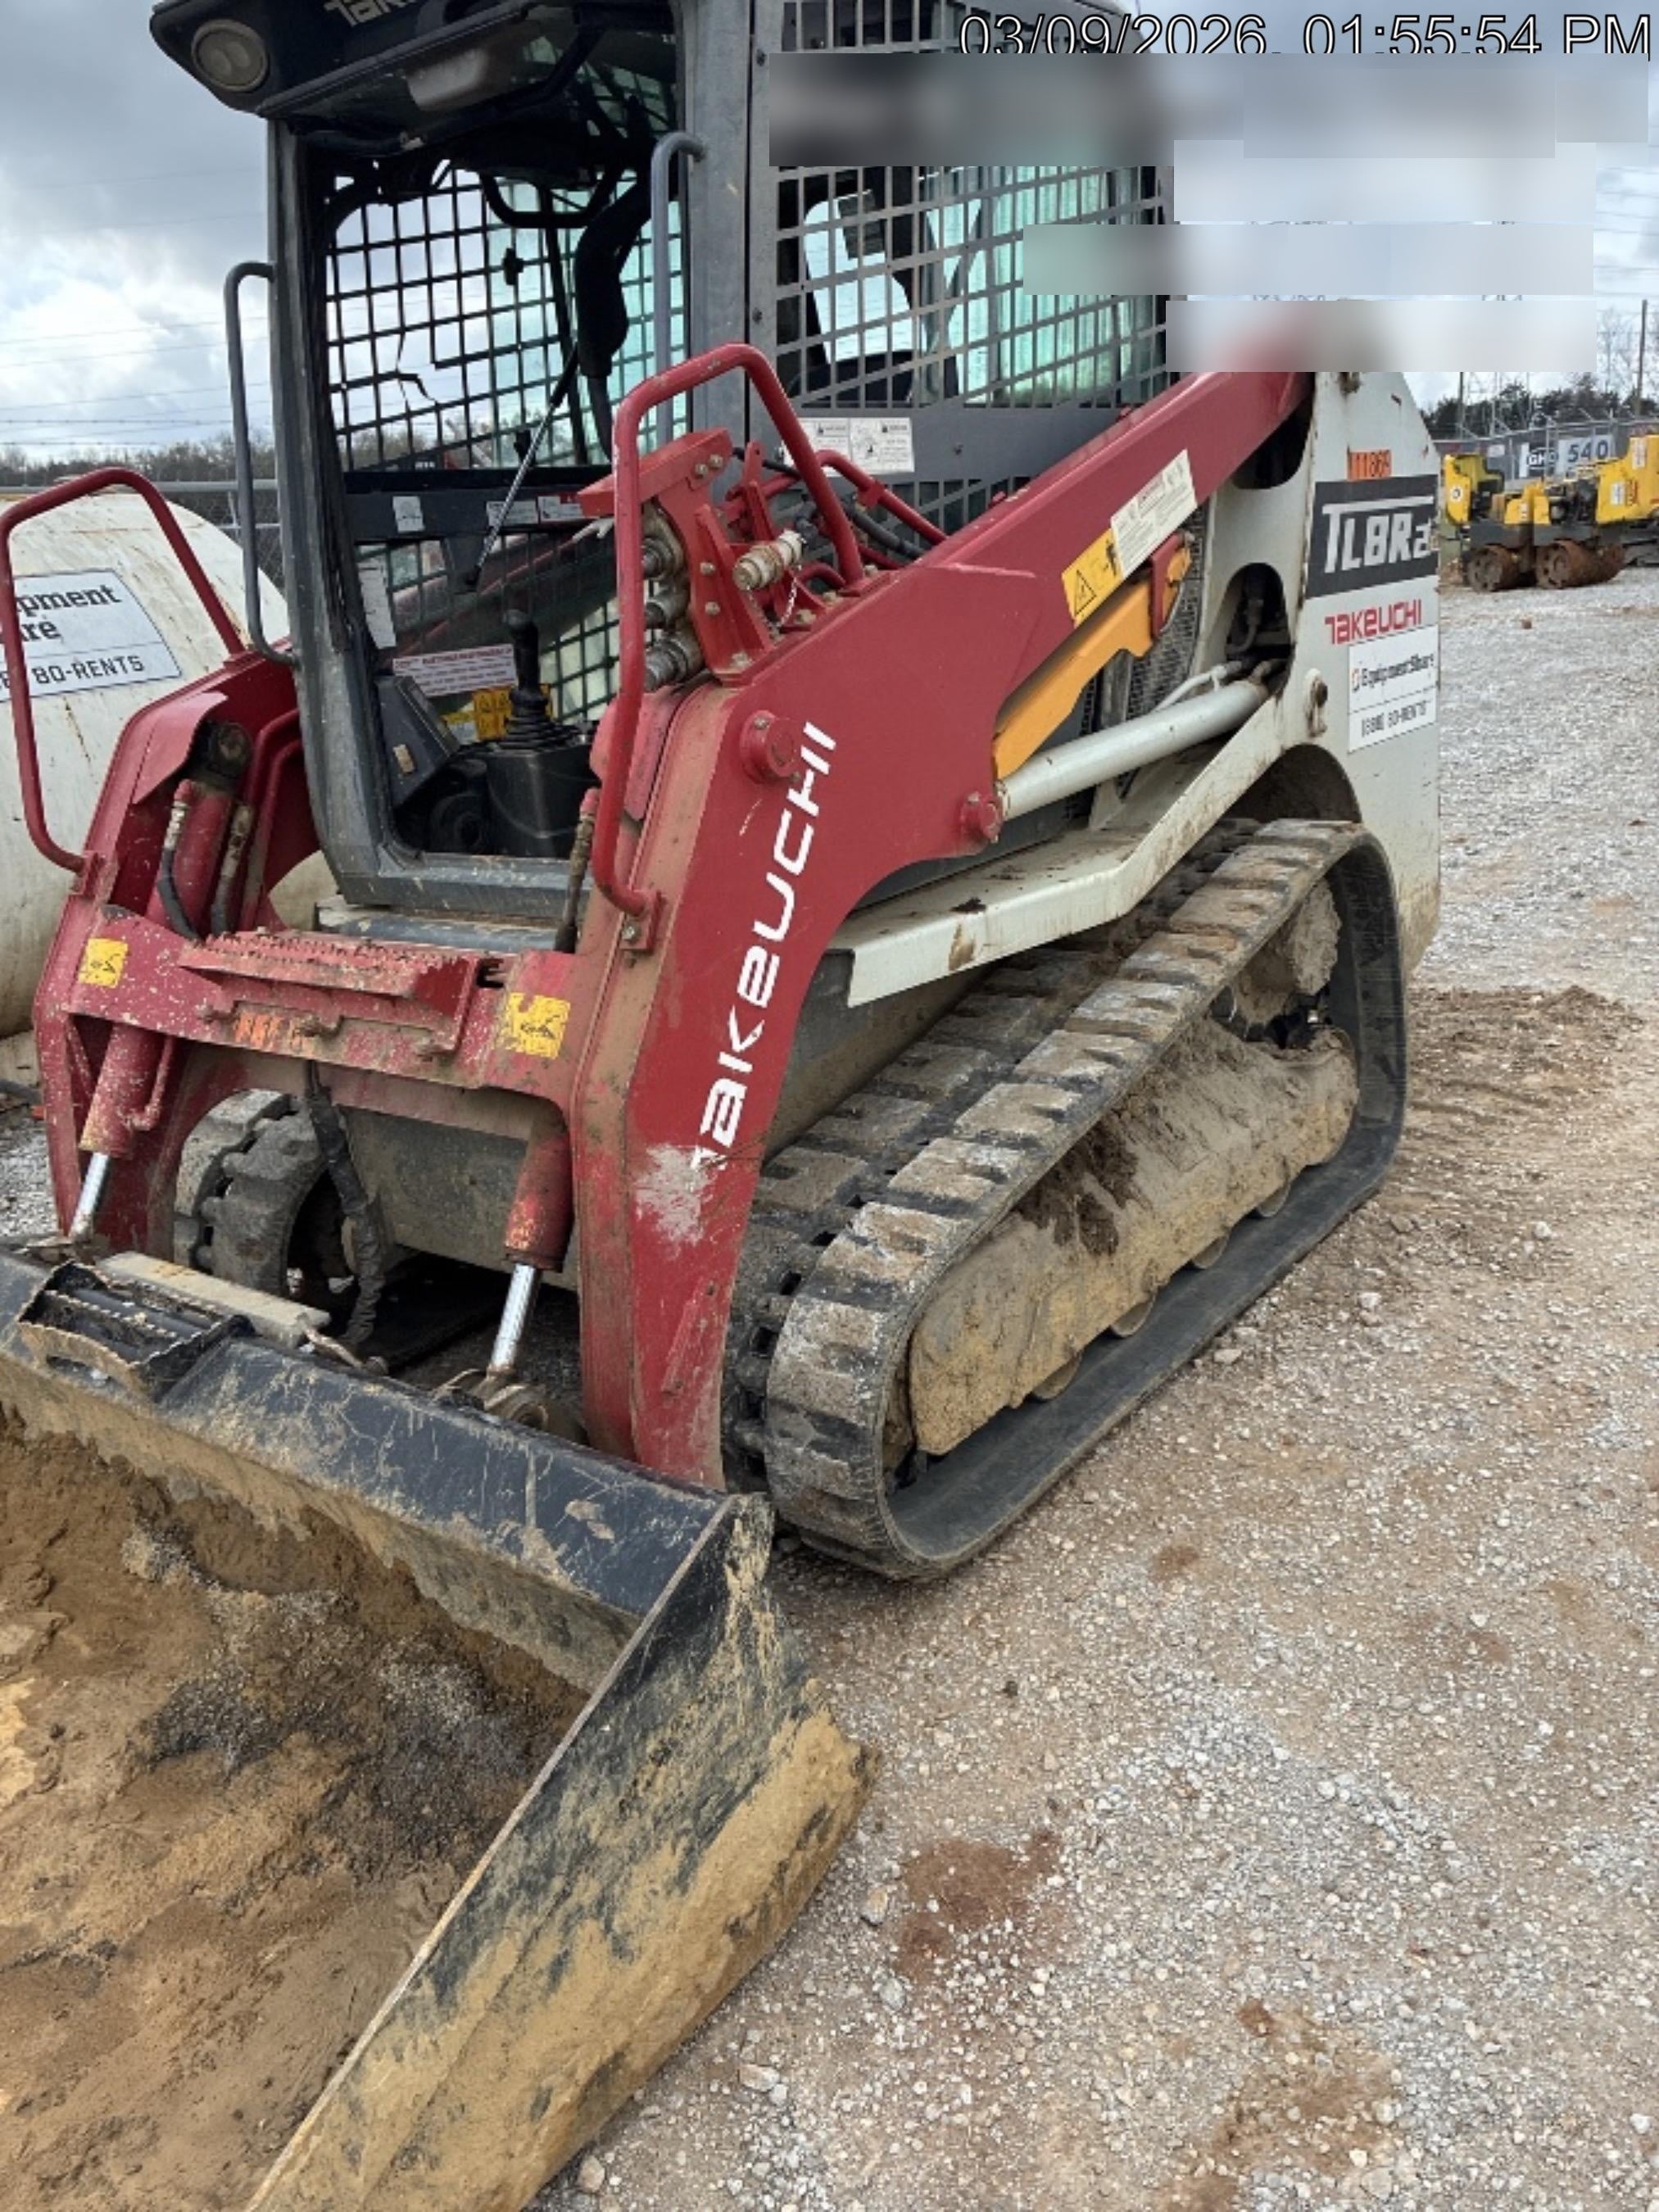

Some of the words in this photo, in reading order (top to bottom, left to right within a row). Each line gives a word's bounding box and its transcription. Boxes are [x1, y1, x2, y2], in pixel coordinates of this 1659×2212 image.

[1567, 439, 1609, 463] 540
[16, 584, 122, 617] pment
[31, 655, 144, 685] 80-RENTS
